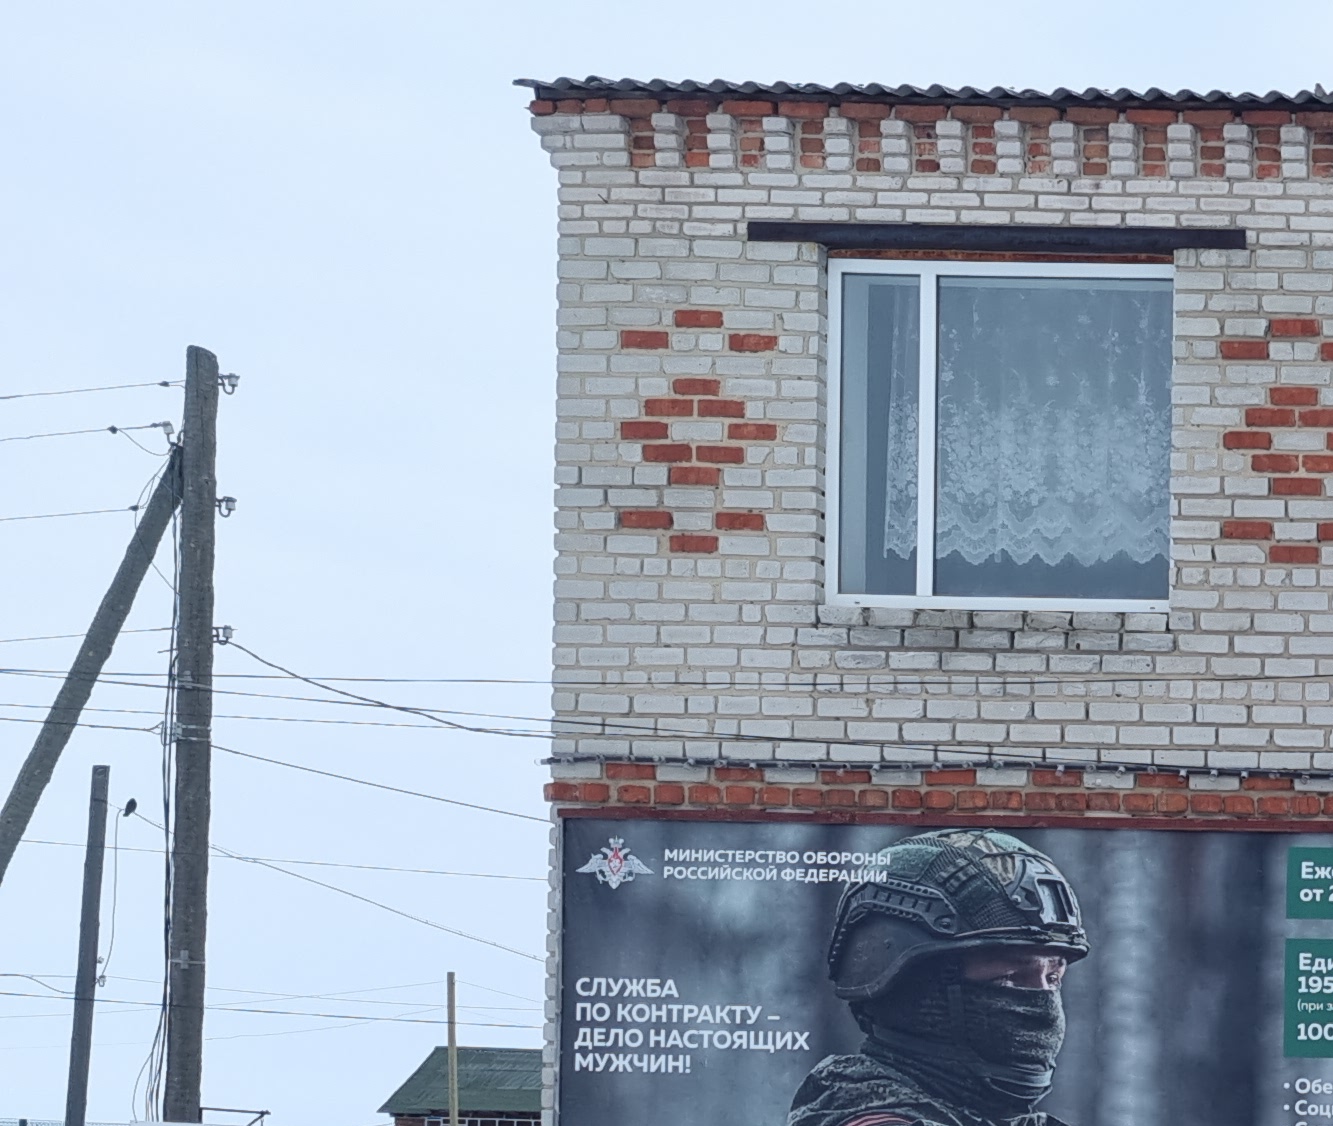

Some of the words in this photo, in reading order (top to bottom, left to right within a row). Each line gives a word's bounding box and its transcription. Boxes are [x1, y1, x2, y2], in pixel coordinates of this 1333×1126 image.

[664, 849, 799, 865] МИНИСТЕРСТВО
[803, 850, 891, 866] ОБОРОНЫ
[663, 863, 778, 882] РОССИЙСКОЙ
[781, 867, 888, 884] ФЕДЕРАЦИИ
[1300, 888, 1324, 903] от
[576, 977, 679, 999] СЛУЖБА
[576, 1003, 609, 1023] ПО
[617, 1004, 762, 1025] КОНТРАКТУ
[1297, 1000, 1324, 1014] (при
[573, 1028, 644, 1050] ДЕЛО
[649, 1029, 810, 1054] НАСТОЯЩИХ
[574, 1053, 692, 1074] МУЖЧИН!
